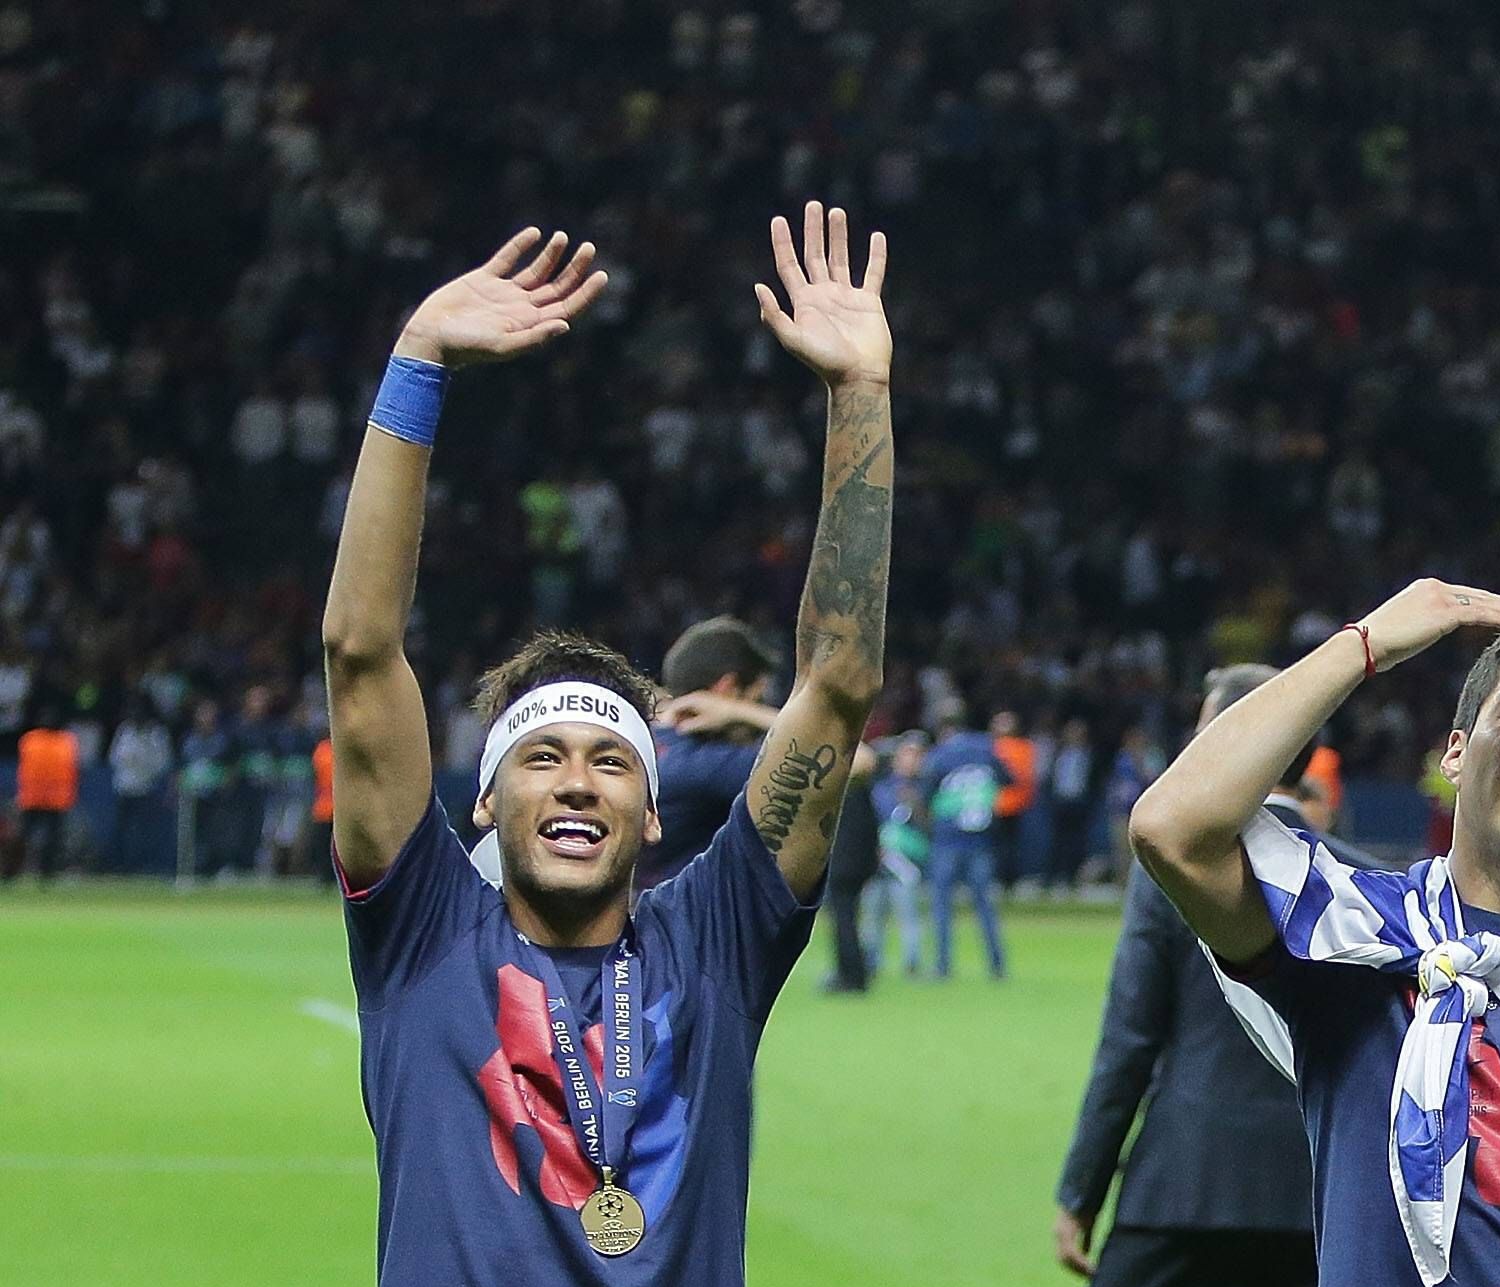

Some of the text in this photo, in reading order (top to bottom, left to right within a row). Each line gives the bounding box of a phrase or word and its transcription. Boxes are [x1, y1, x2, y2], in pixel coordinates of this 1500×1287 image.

[507, 694, 620, 734] 100% JESUS
[614, 960, 630, 1078] NAL BERLIN 2015
[551, 1021, 600, 1165] INAL BERLIN 2015
